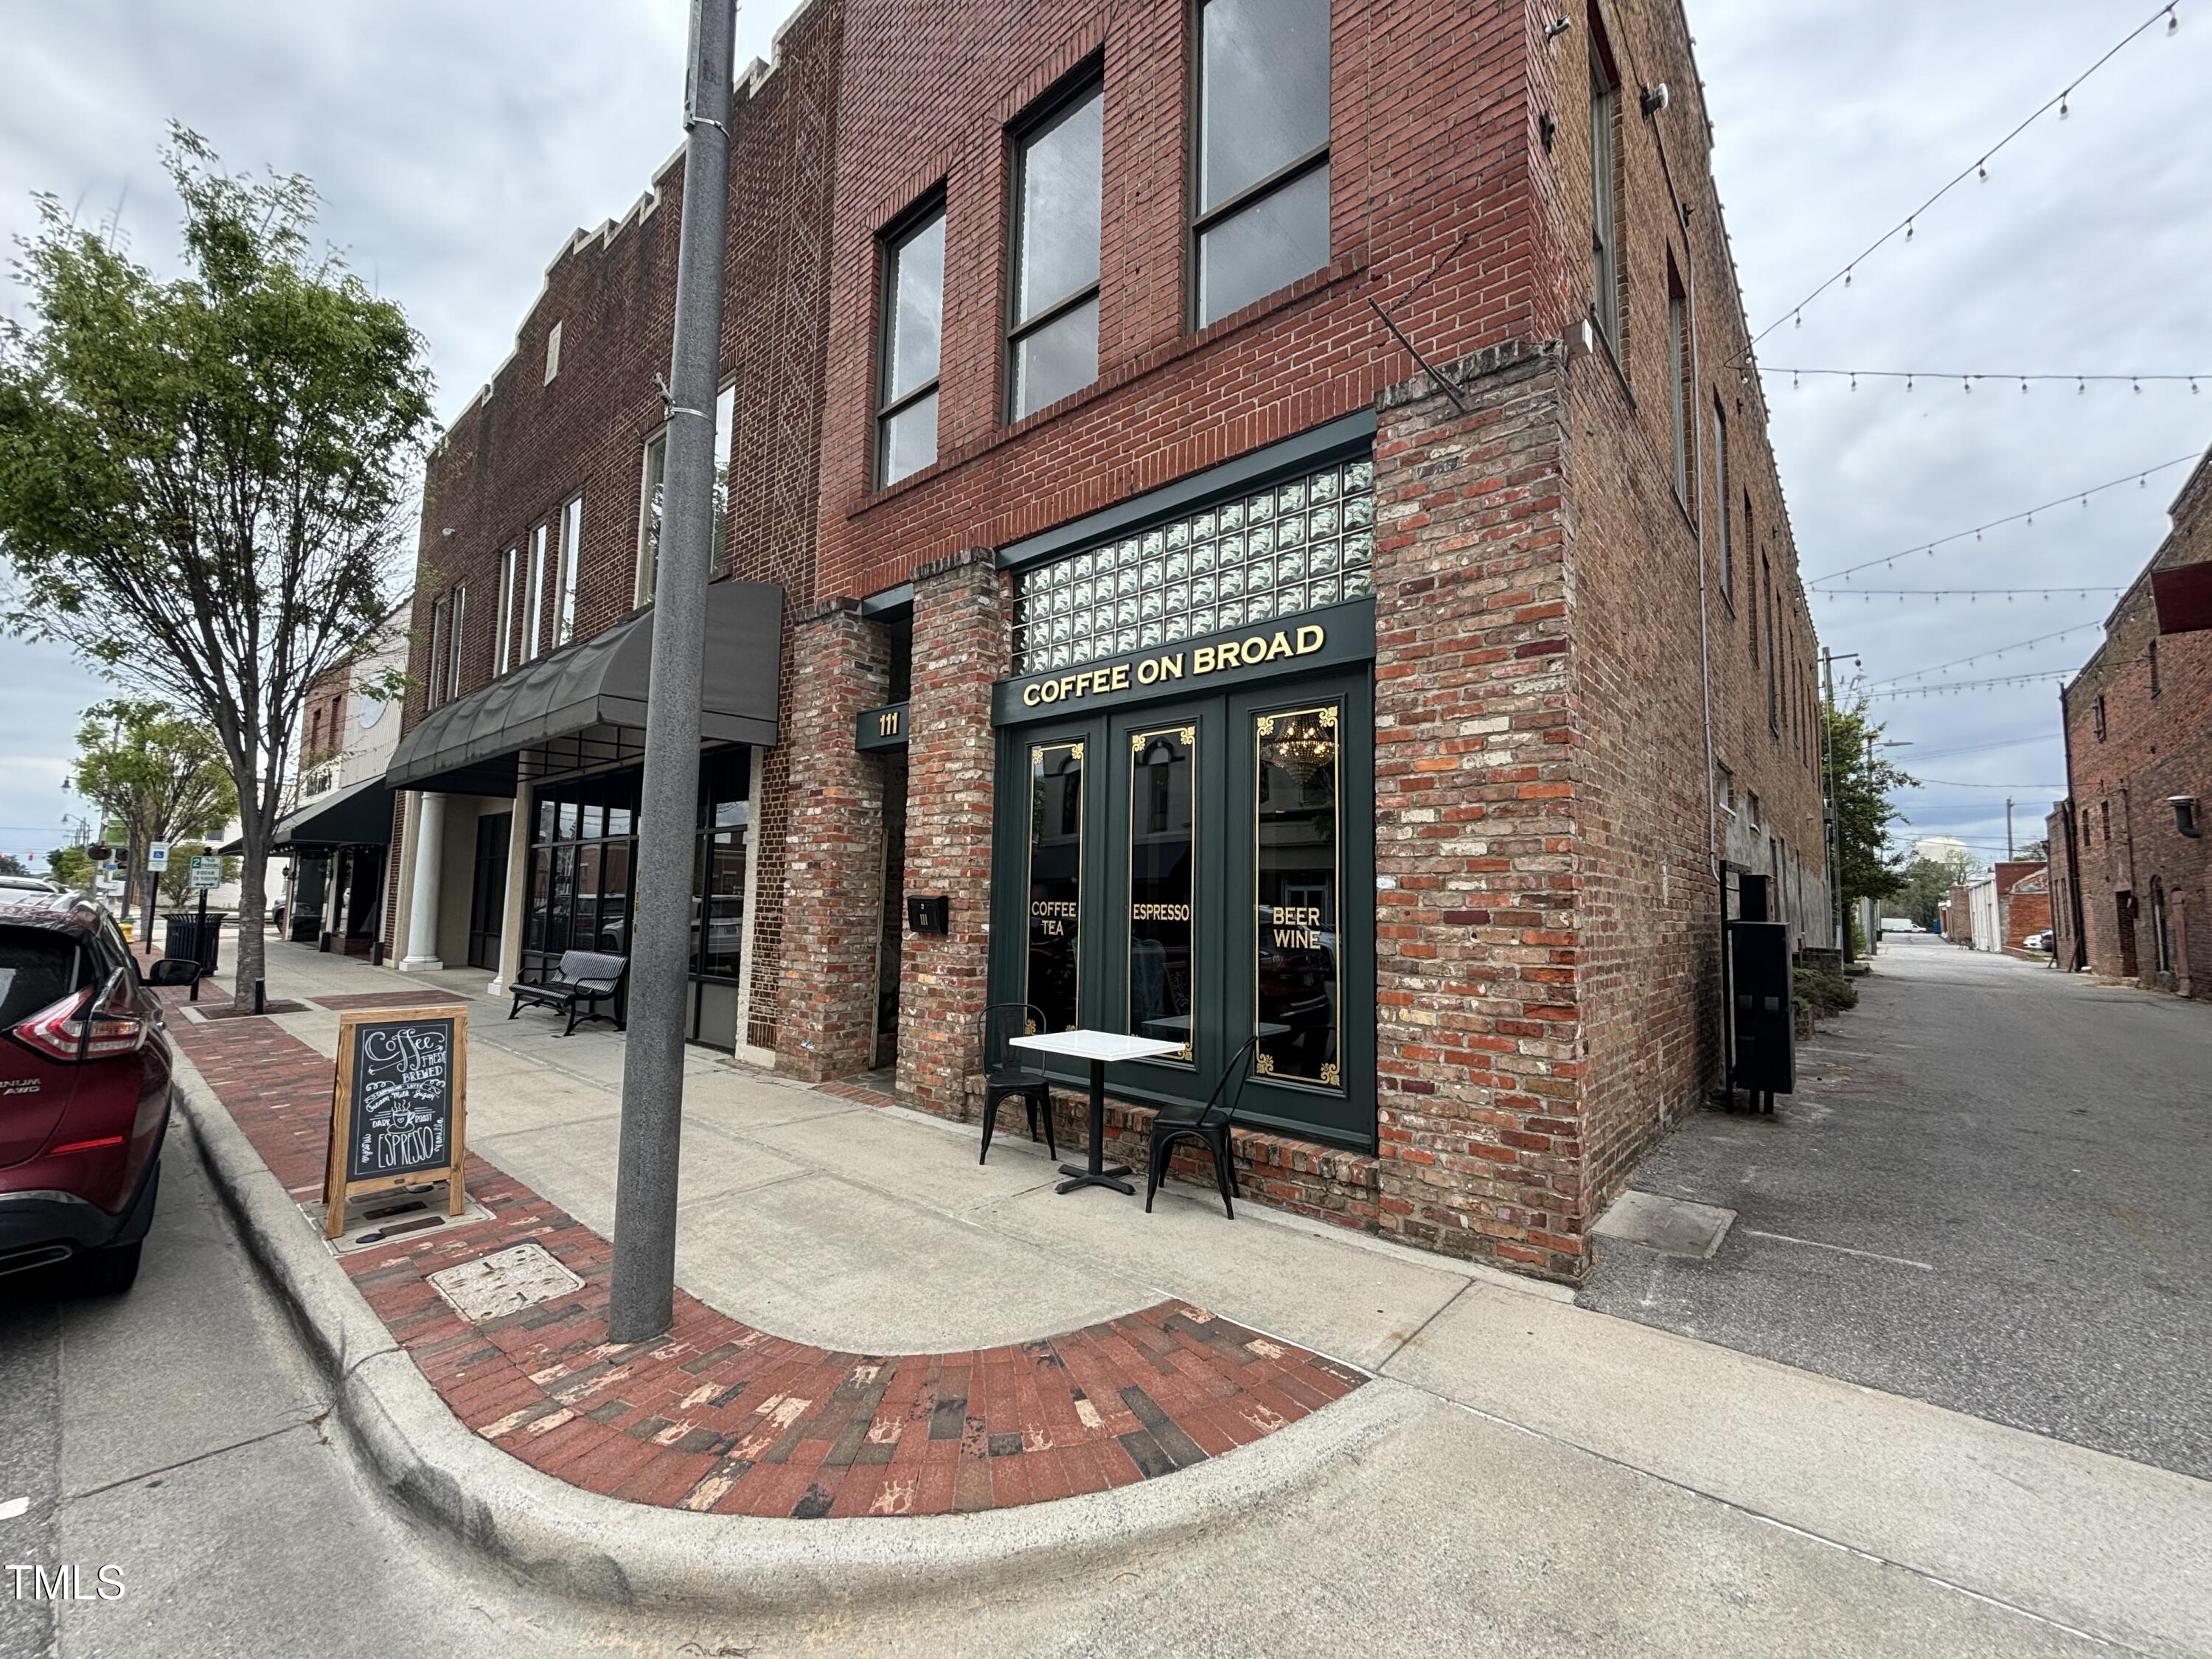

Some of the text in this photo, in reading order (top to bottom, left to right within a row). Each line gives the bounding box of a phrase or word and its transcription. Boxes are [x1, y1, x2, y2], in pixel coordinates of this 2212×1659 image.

[1023, 625, 1325, 707] COFFEE ON BROAD
[880, 712, 898, 736] 111
[192, 858, 200, 867] 2
[1032, 901, 1077, 919] COFFEE
[1133, 903, 1190, 922] ESPRESSO
[1273, 906, 1320, 927] BEER
[1041, 920, 1064, 936] TEA
[1273, 929, 1321, 950] WINE
[365, 1029, 445, 1073] Coffee
[421, 1051, 446, 1067] FRESH
[402, 1065, 442, 1083] BREWED
[3, 1086, 40, 1096] AWD
[366, 1090, 436, 1112] Cream Milk Sugar
[372, 1113, 433, 1128] DARK ROAST
[378, 1127, 434, 1168] ESPRESSO
